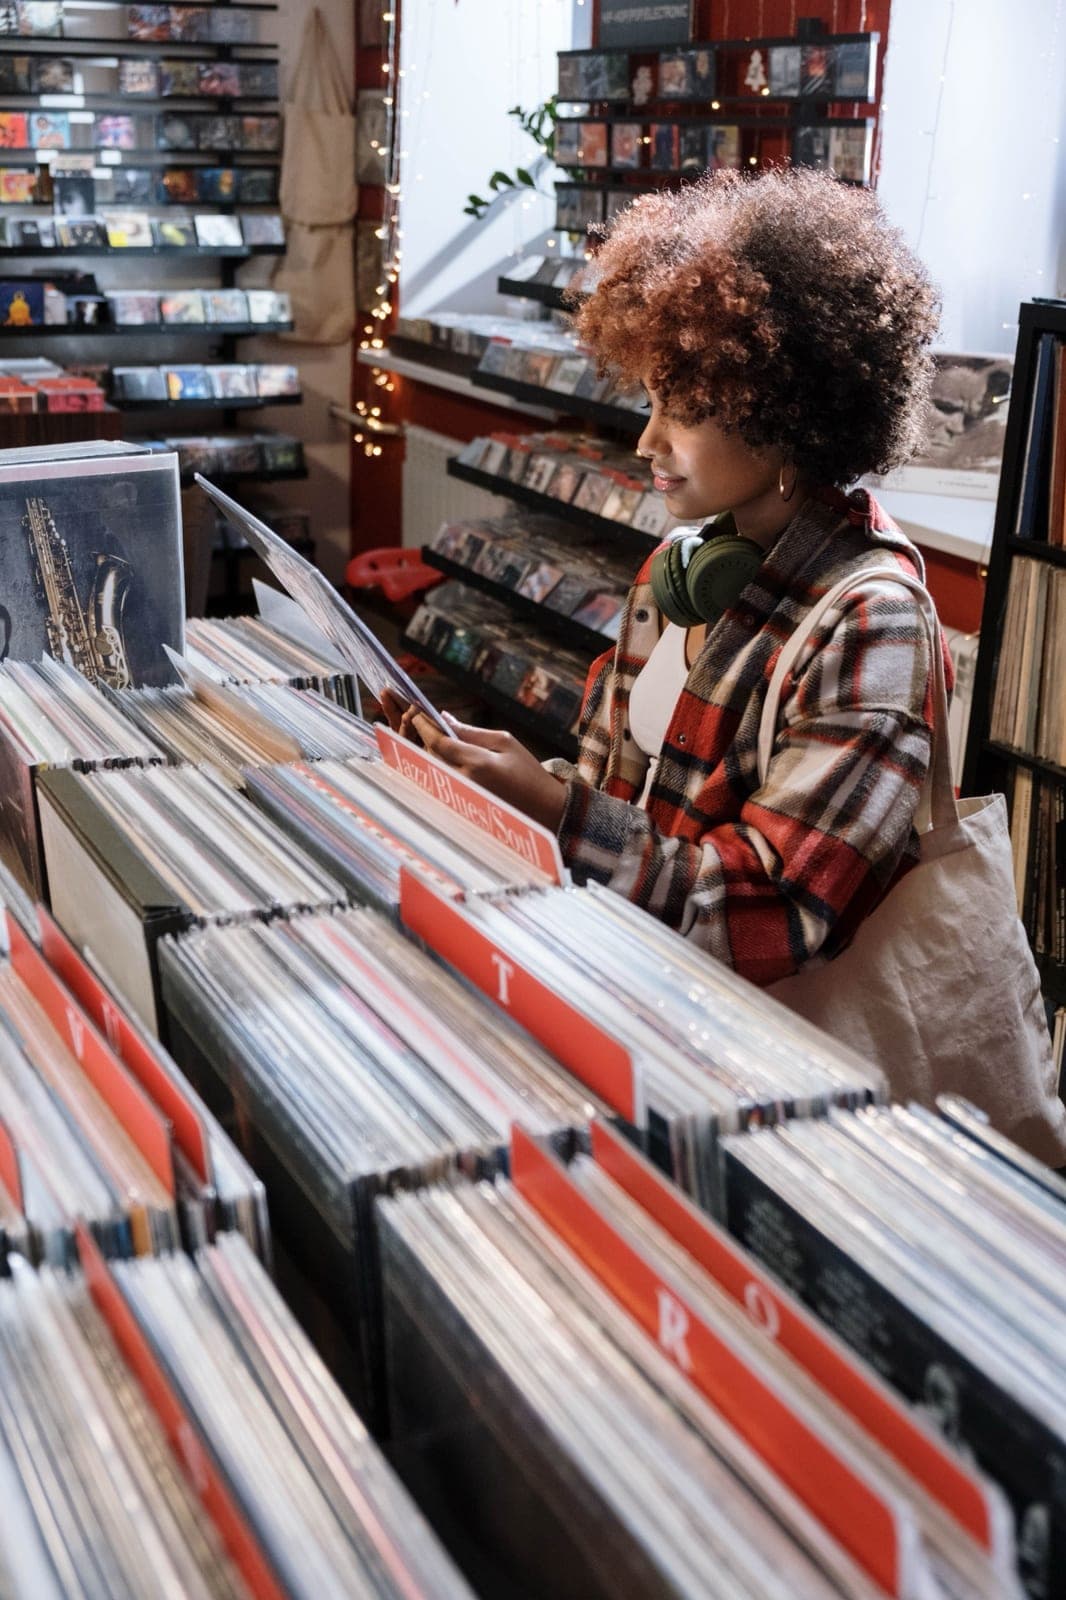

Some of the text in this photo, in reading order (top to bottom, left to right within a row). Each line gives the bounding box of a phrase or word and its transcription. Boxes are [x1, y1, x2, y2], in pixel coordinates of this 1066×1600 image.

[391, 739, 541, 868] Jazz/Blues/Soul
[491, 952, 515, 1005] T
[657, 1284, 691, 1372] R
